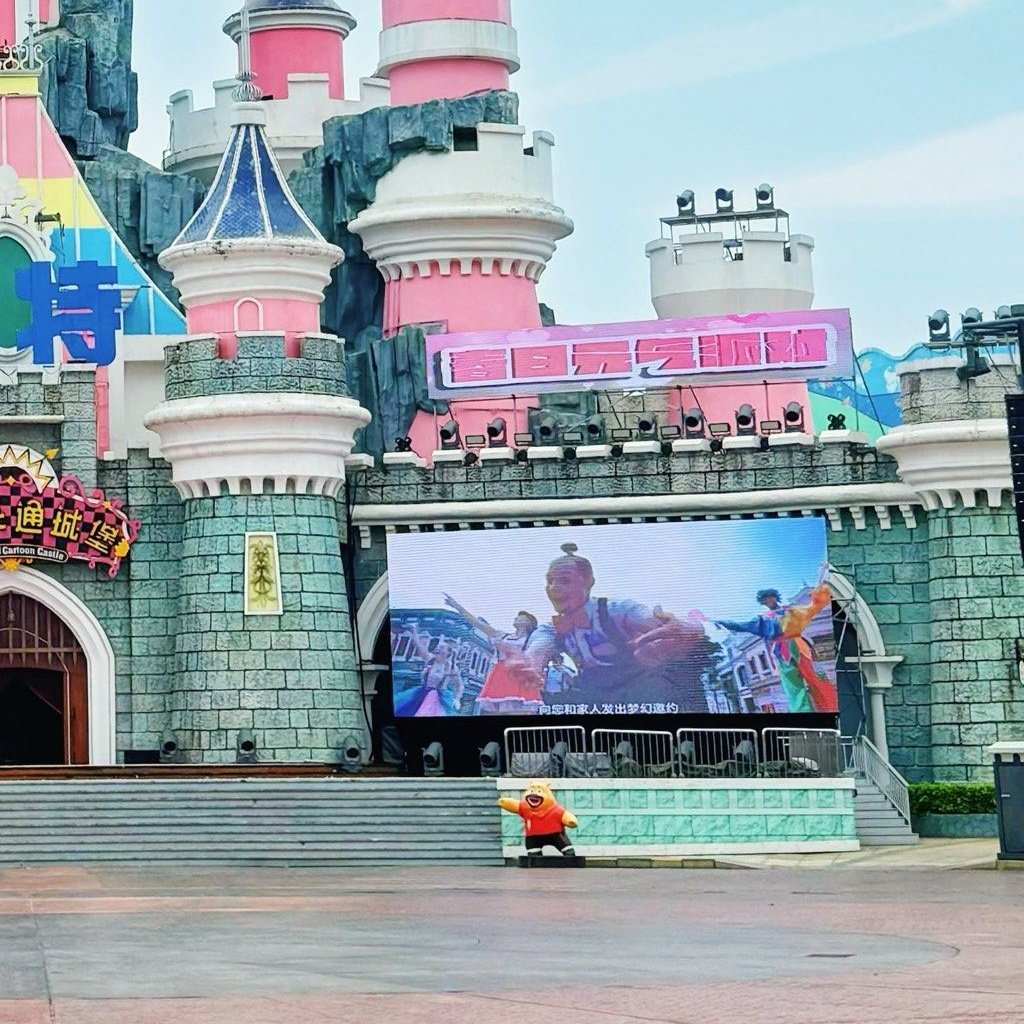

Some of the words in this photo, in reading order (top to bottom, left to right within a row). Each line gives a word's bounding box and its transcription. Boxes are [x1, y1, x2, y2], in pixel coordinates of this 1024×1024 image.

[2, 546, 35, 555] Cartoon
[37, 547, 64, 560] Castle
[539, 702, 679, 715] 向您和家人发出梦幻邀约
